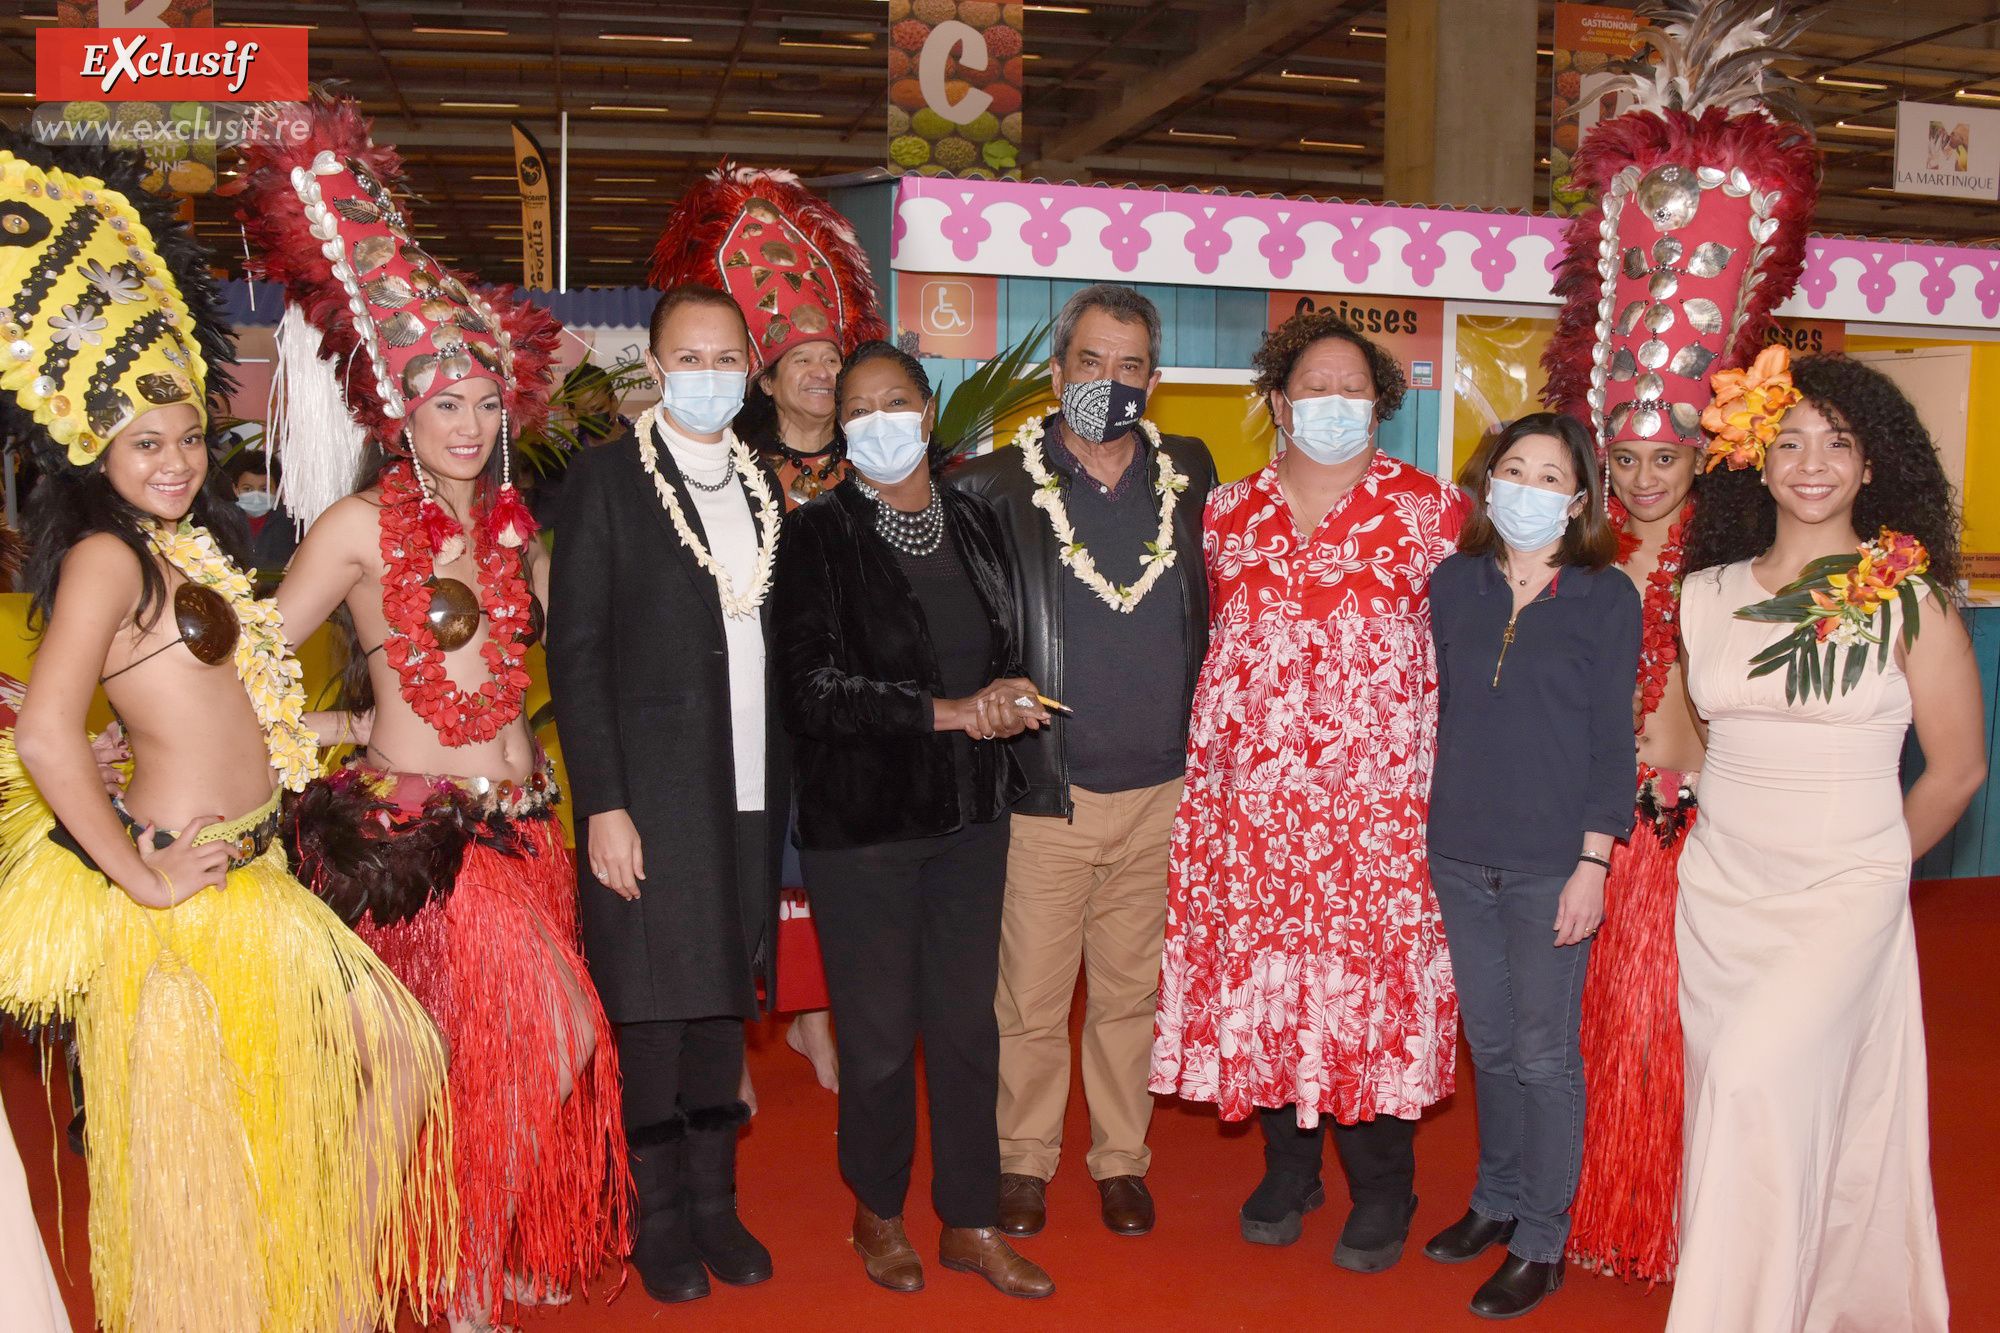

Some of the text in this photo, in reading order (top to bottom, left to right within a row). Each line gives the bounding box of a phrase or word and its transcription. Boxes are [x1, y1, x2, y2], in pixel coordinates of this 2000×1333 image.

[1581, 18, 1638, 31] GASTRONOMIE
[919, 20, 994, 125] C
[1898, 171, 1995, 191] LA MARTINIQUE
